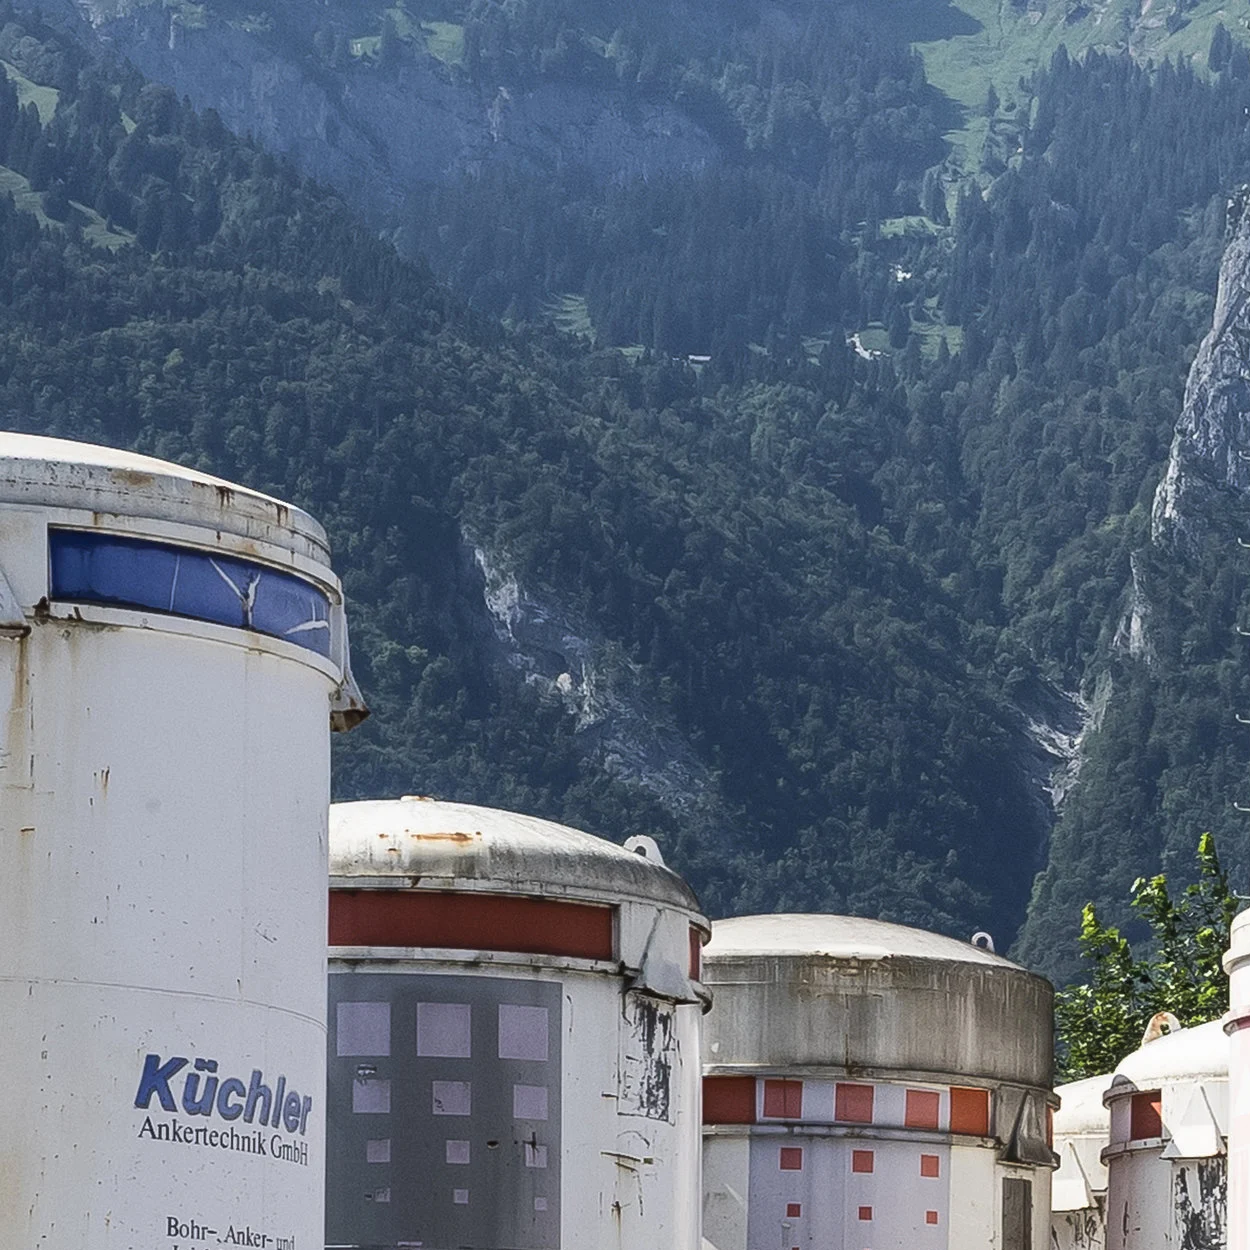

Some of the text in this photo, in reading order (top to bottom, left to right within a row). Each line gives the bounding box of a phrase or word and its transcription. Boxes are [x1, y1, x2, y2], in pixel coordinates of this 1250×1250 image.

[134, 1054, 312, 1136] Küchler
[138, 1116, 308, 1166] Ankertechnik GmbH
[223, 1225, 274, 1248] Anker-
